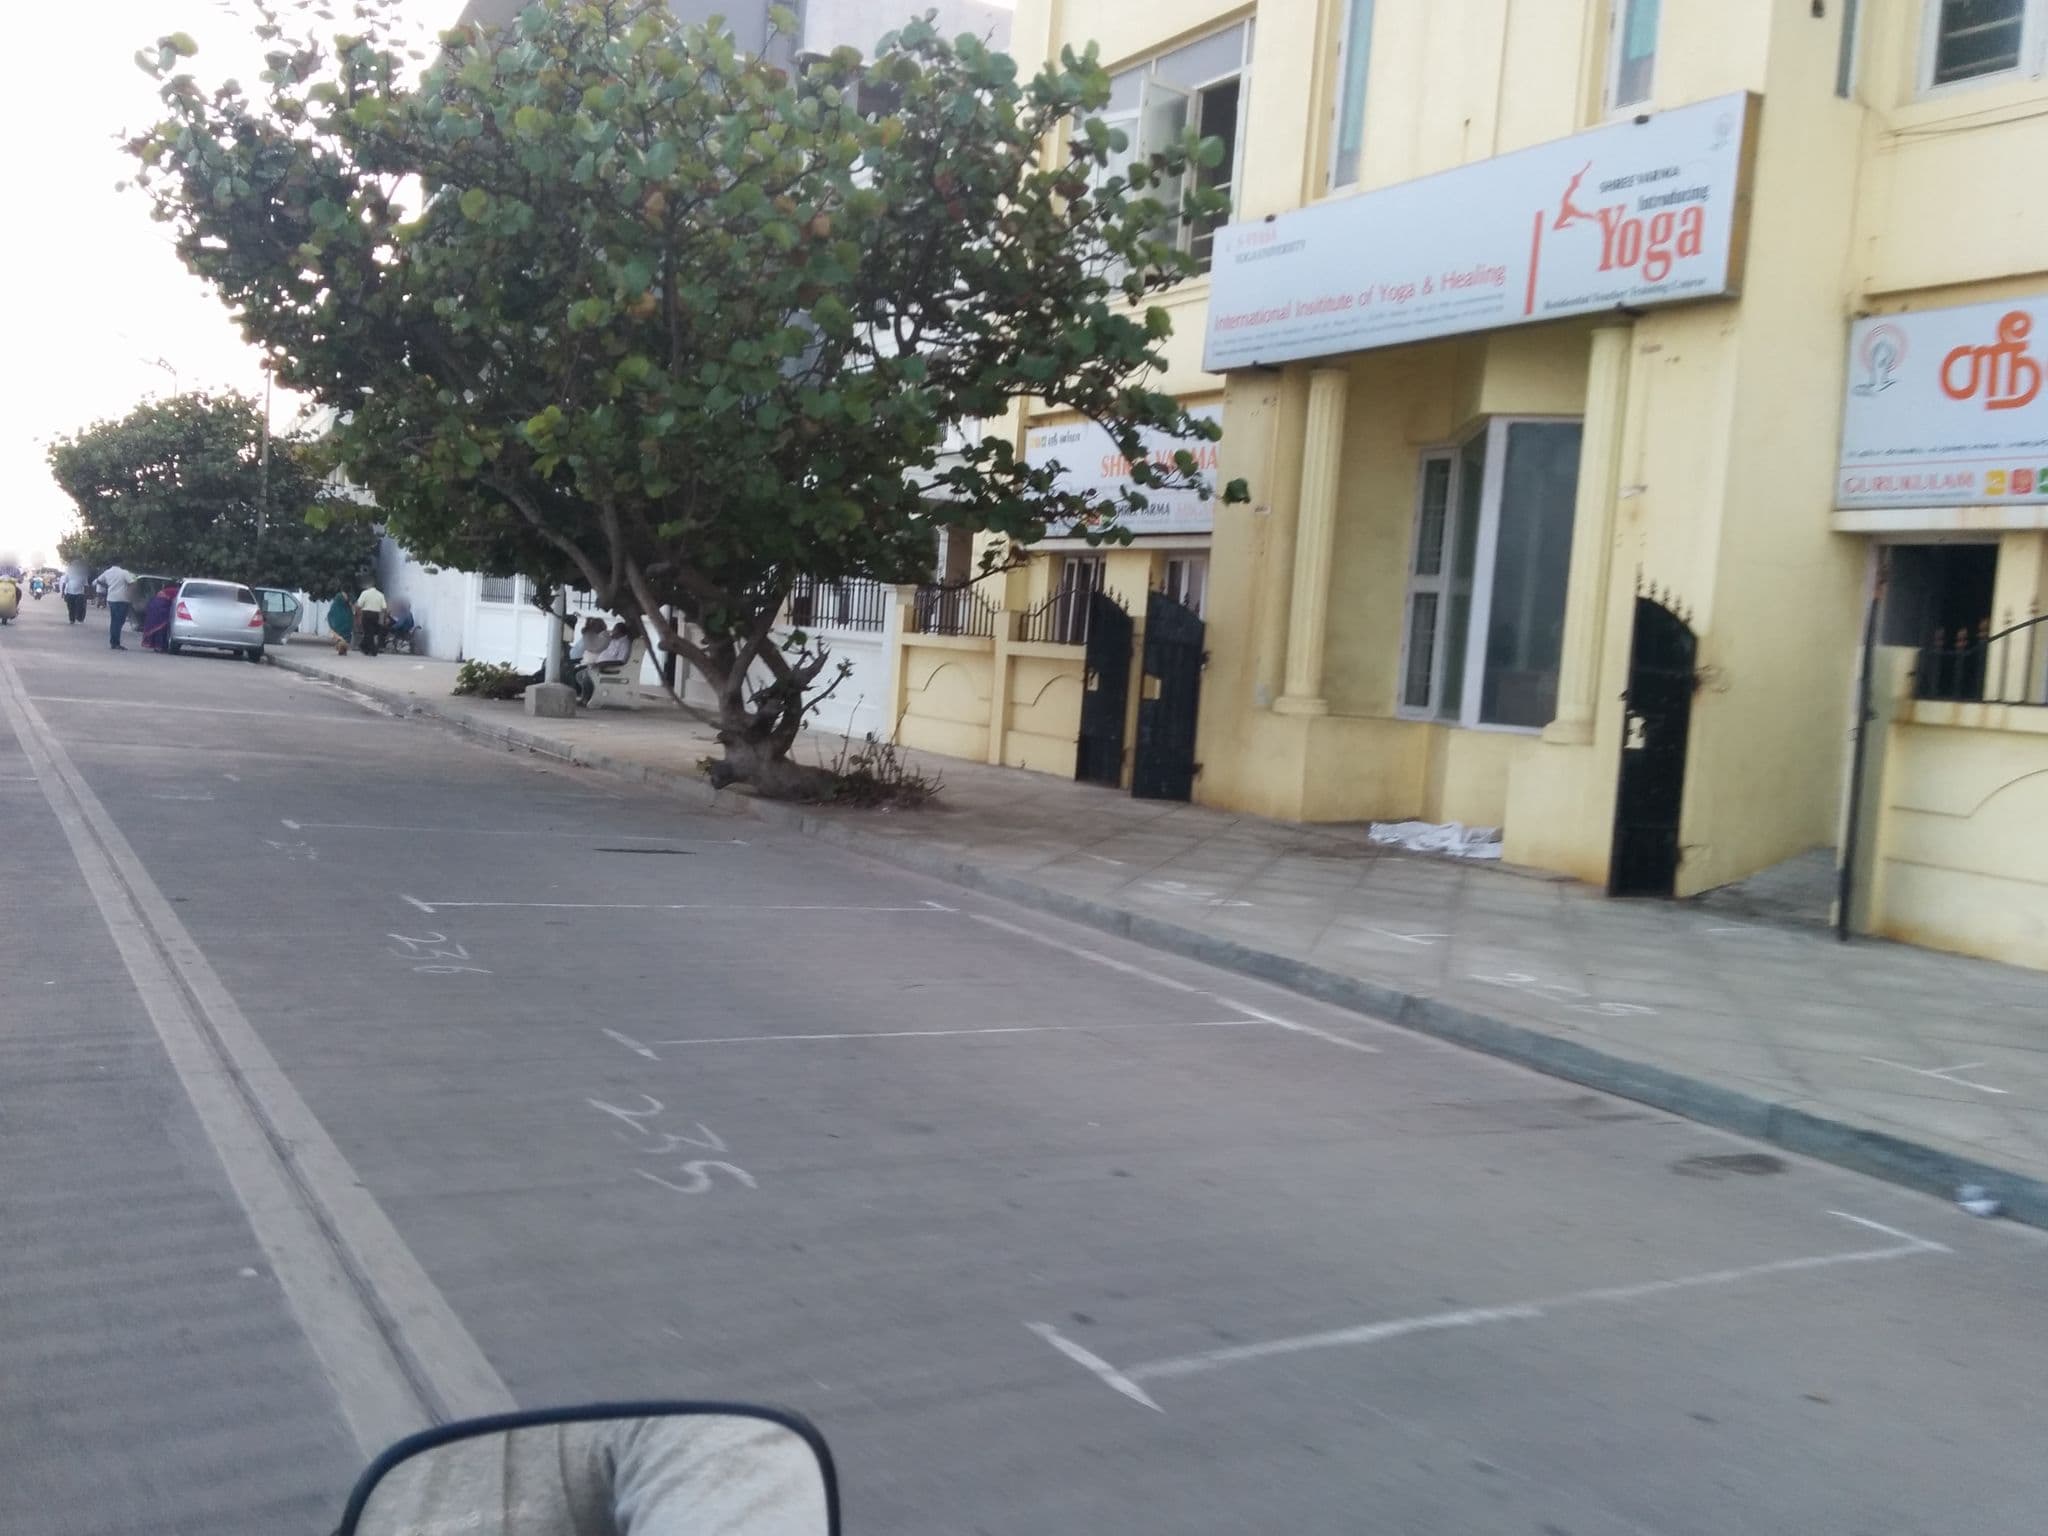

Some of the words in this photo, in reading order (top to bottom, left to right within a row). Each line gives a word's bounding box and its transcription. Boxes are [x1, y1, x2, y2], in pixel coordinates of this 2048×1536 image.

[1596, 204, 1705, 283] Yoga
[1215, 300, 1292, 331] International
[1295, 293, 1353, 317] Institute
[1359, 282, 1375, 307] of
[1380, 283, 1415, 304] Yoga
[1423, 274, 1433, 295] &
[1441, 264, 1505, 292] Healing
[1155, 445, 1217, 474] VAMA
